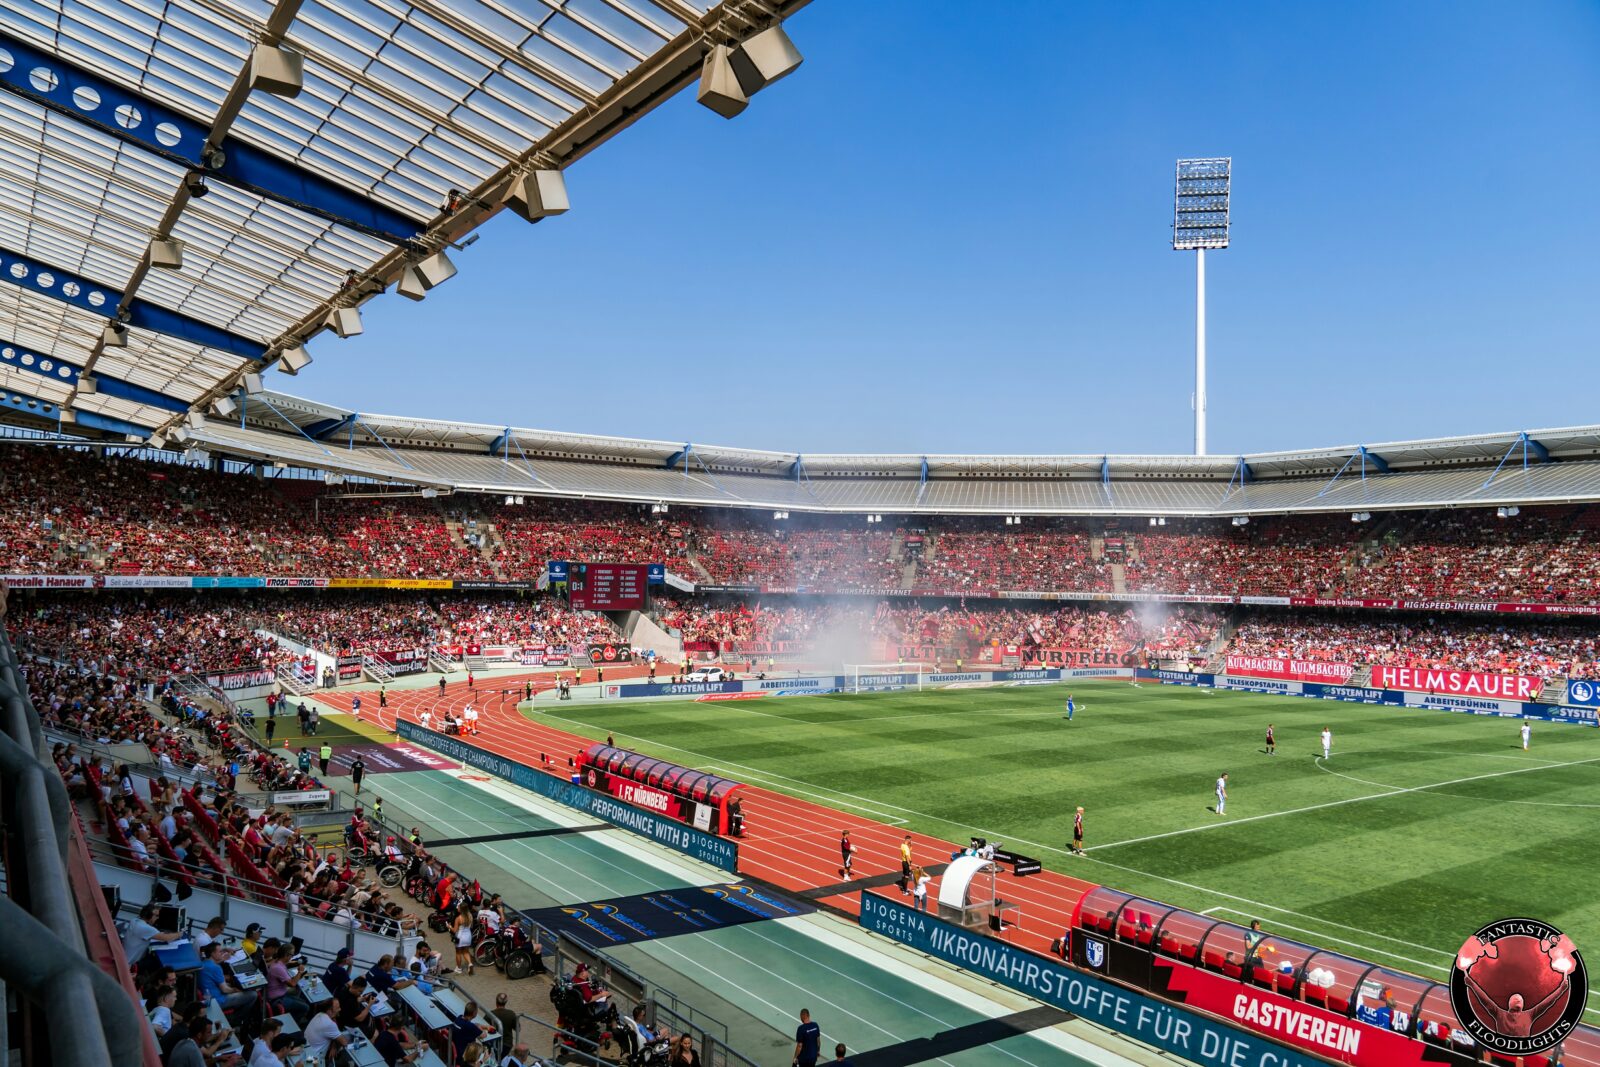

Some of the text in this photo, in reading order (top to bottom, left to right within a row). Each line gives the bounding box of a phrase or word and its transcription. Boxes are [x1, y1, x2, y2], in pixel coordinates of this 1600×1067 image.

[46, 577, 86, 586] Hanauer
[1314, 598, 1336, 606] bisping
[1403, 601, 1498, 611] HIGHSPEED-INTERNET
[1227, 655, 1284, 672] KULMBACHER
[1290, 661, 1351, 677] KULMBACHER
[929, 674, 981, 682] TELESKOPSTAPLER
[1012, 671, 1035, 679] SYSTEM
[1072, 669, 1117, 677] ARBEITSBÜHNEN
[1158, 671, 1198, 682] SYSTEM LIFT
[223, 674, 245, 689] WEISS
[760, 679, 819, 689] ARBEITSBÜHNEN
[860, 676, 903, 685] SYSTEM LIFT
[1227, 679, 1288, 690] TELESKOPSTAPLER
[1382, 667, 1530, 697] HELMSAUER
[671, 683, 723, 693] SYSTEM LIFT
[1331, 686, 1382, 699] SYSTEM LIFT
[1424, 696, 1499, 710] ARBEITSBÜHNEN
[468, 751, 499, 772] CHAMPIONS
[499, 761, 511, 777] VON
[618, 784, 668, 811] 1. FC NÜRNBERG
[592, 799, 653, 834] PERFORMANCE
[655, 821, 680, 846] WITH
[682, 832, 689, 849] B
[692, 834, 731, 858] BIOGENA
[699, 849, 723, 866] SPORTS
[865, 898, 926, 933] BIOGENA
[876, 919, 913, 942] SPORTS
[1233, 993, 1361, 1055] GASTVEREIN
[1137, 1005, 1192, 1049] FÜR
[1200, 1029, 1250, 1067] DIE
